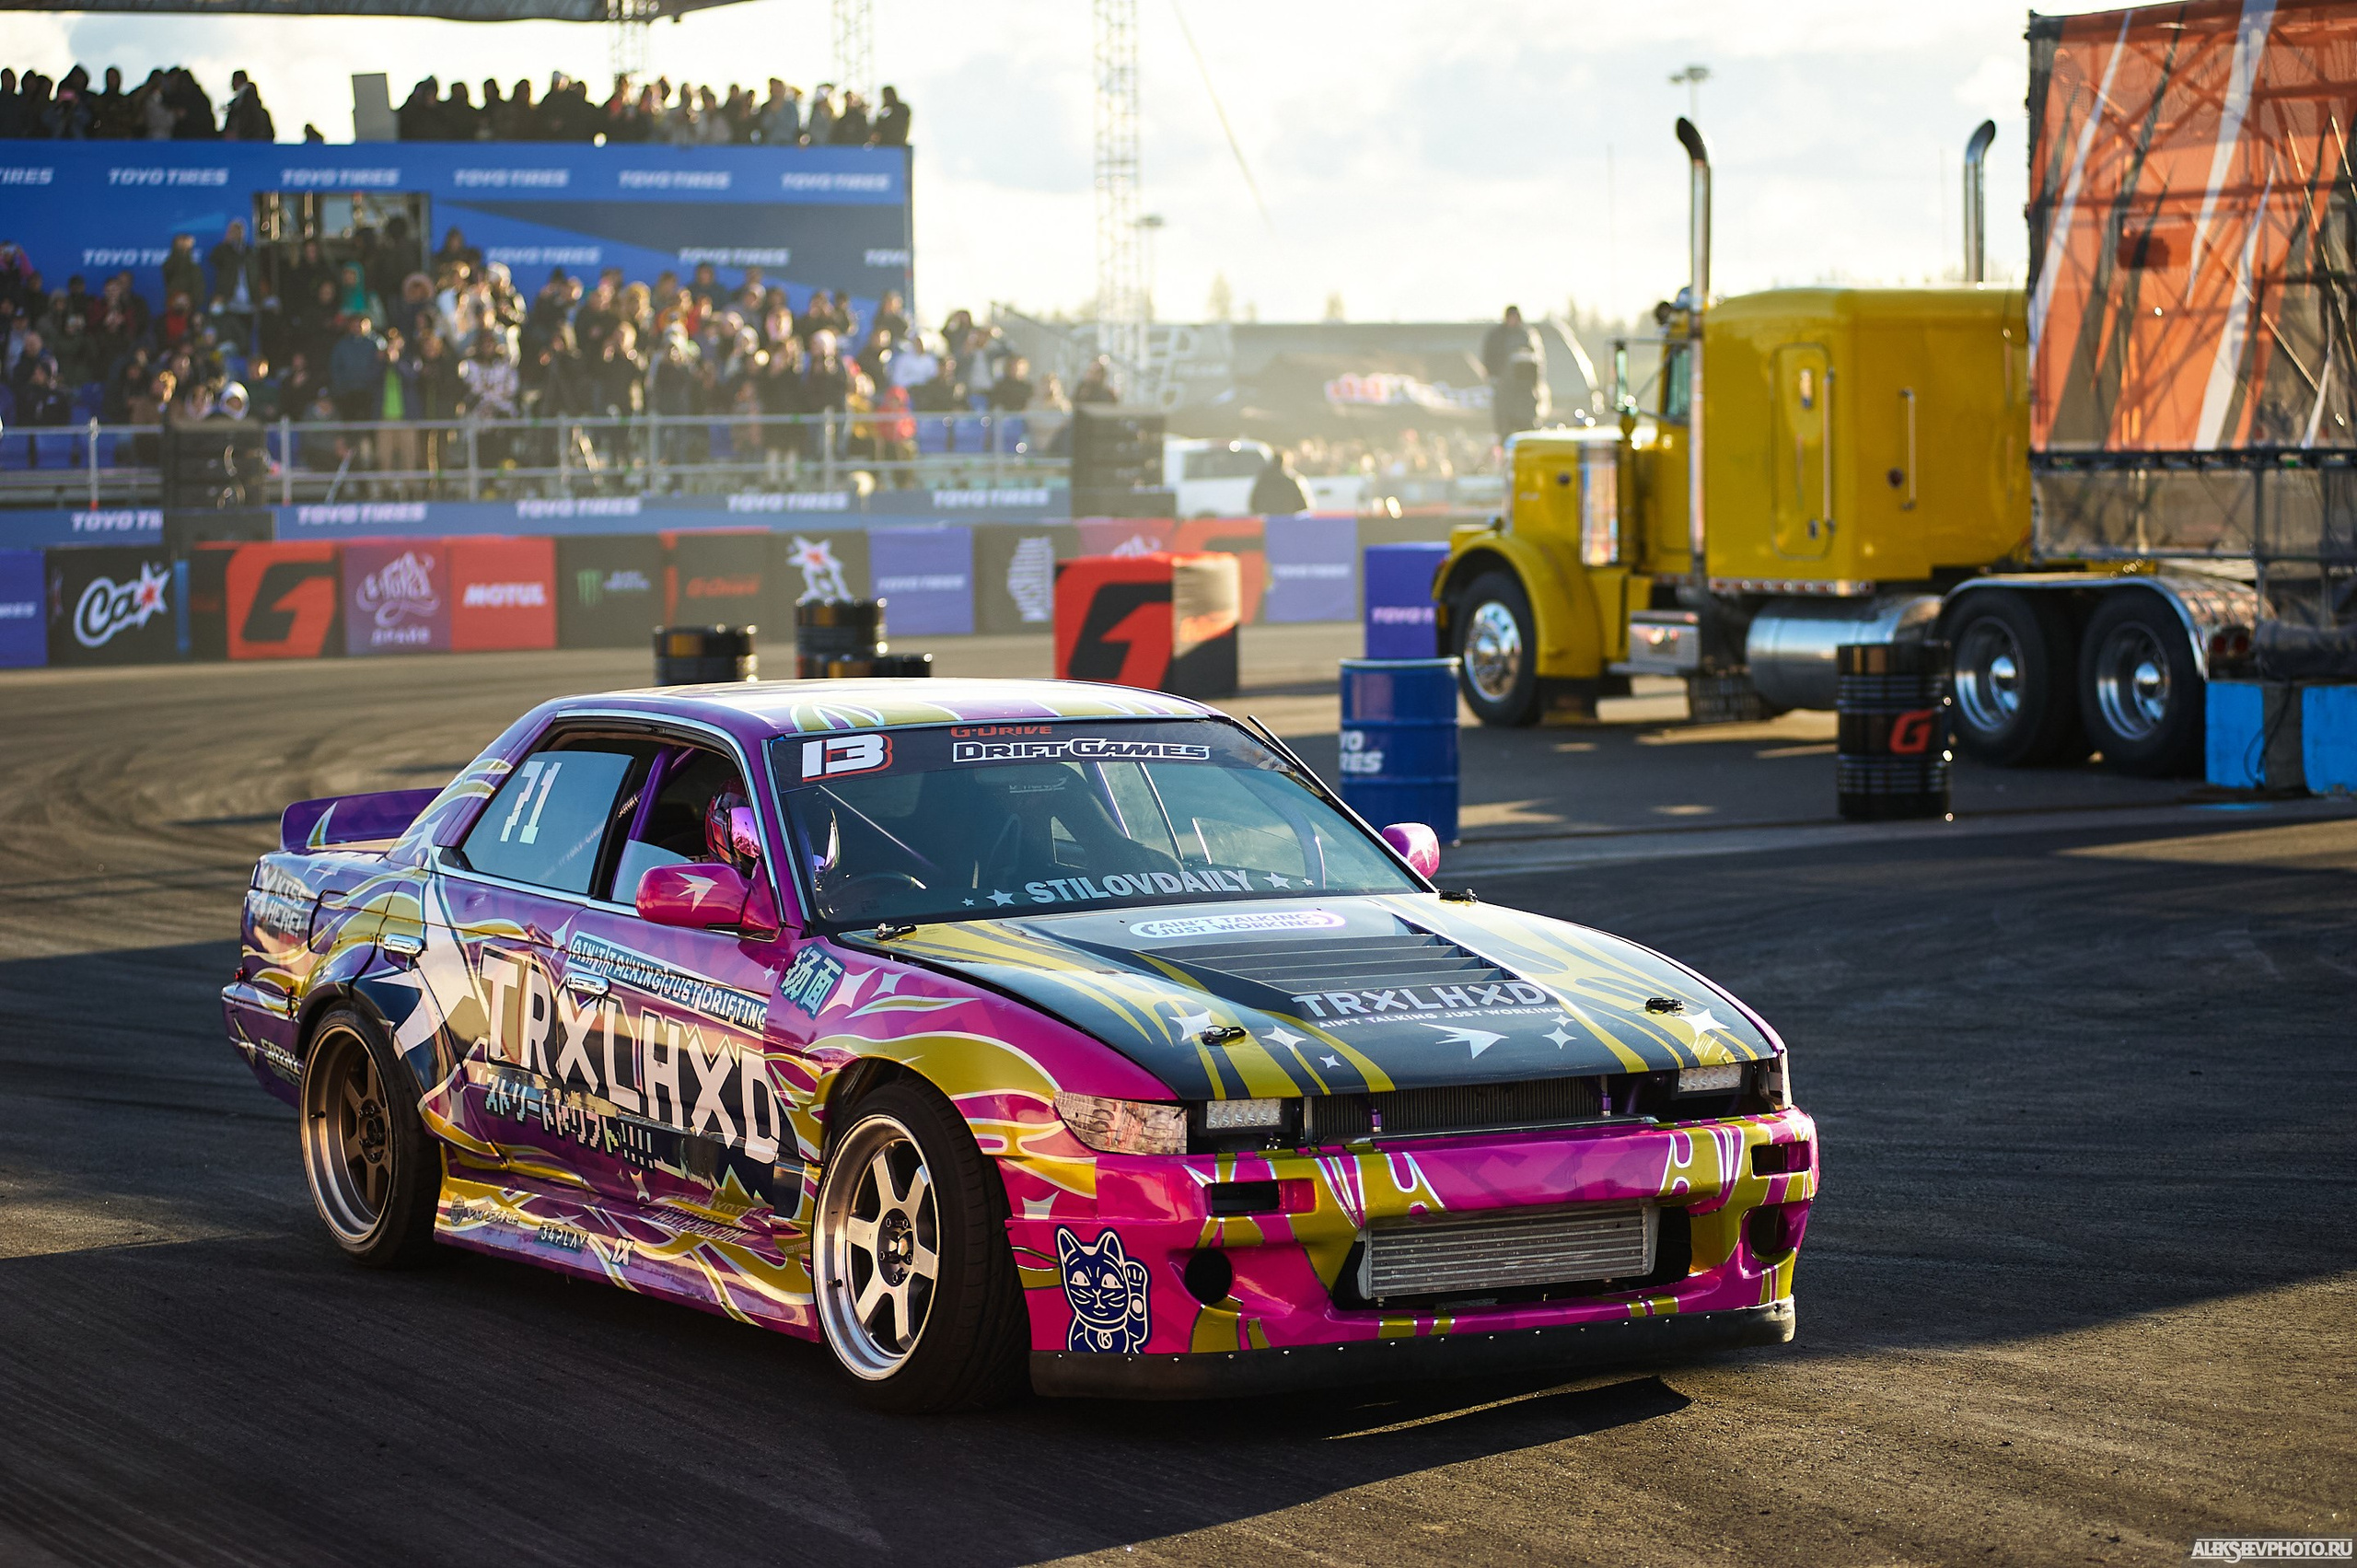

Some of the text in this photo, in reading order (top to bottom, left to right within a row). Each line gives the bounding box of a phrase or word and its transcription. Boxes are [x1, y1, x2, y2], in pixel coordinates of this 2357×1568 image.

[0, 168, 53, 184] IRES
[109, 168, 229, 184] TOYO TIRES
[83, 248, 138, 266] TOYO
[72, 511, 135, 531] TOYO
[463, 584, 547, 606] MOTUL
[950, 725, 1053, 738] G-DRIVE
[500, 761, 563, 844] 71
[1024, 868, 1255, 904] STILOVDAILY
[1160, 919, 1320, 935] JUST WORKING
[1291, 983, 1548, 1017] TRXLHXD
[1365, 1012, 1438, 1024] TALKING
